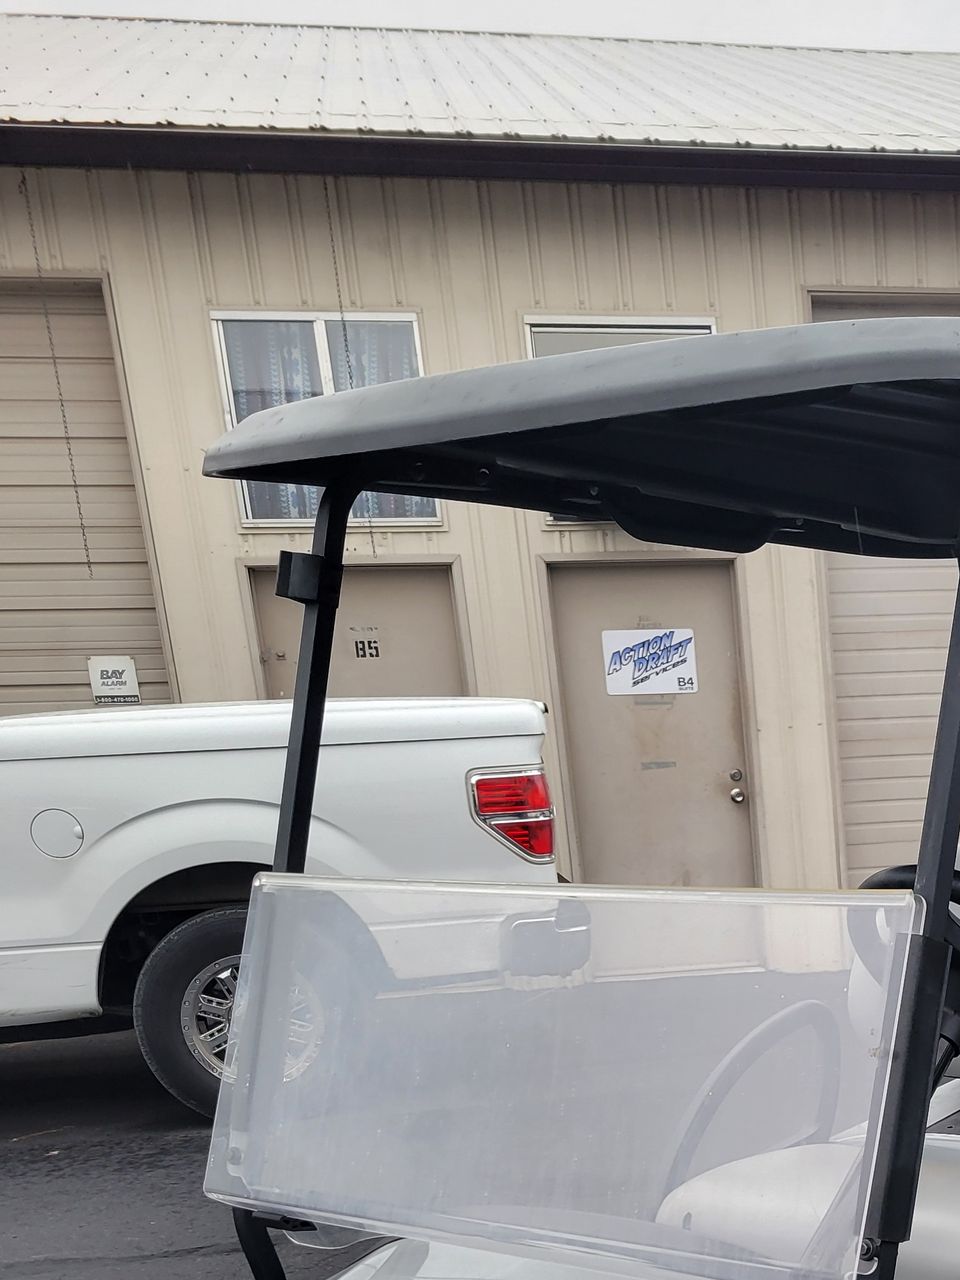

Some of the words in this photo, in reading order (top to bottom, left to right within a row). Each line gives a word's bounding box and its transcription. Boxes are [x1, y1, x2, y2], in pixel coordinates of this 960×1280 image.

[354, 640, 380, 658] B5
[607, 631, 675, 676] ACTION
[632, 637, 693, 680] DRAFT
[100, 669, 126, 679] BAY
[677, 676, 694, 686] B4
